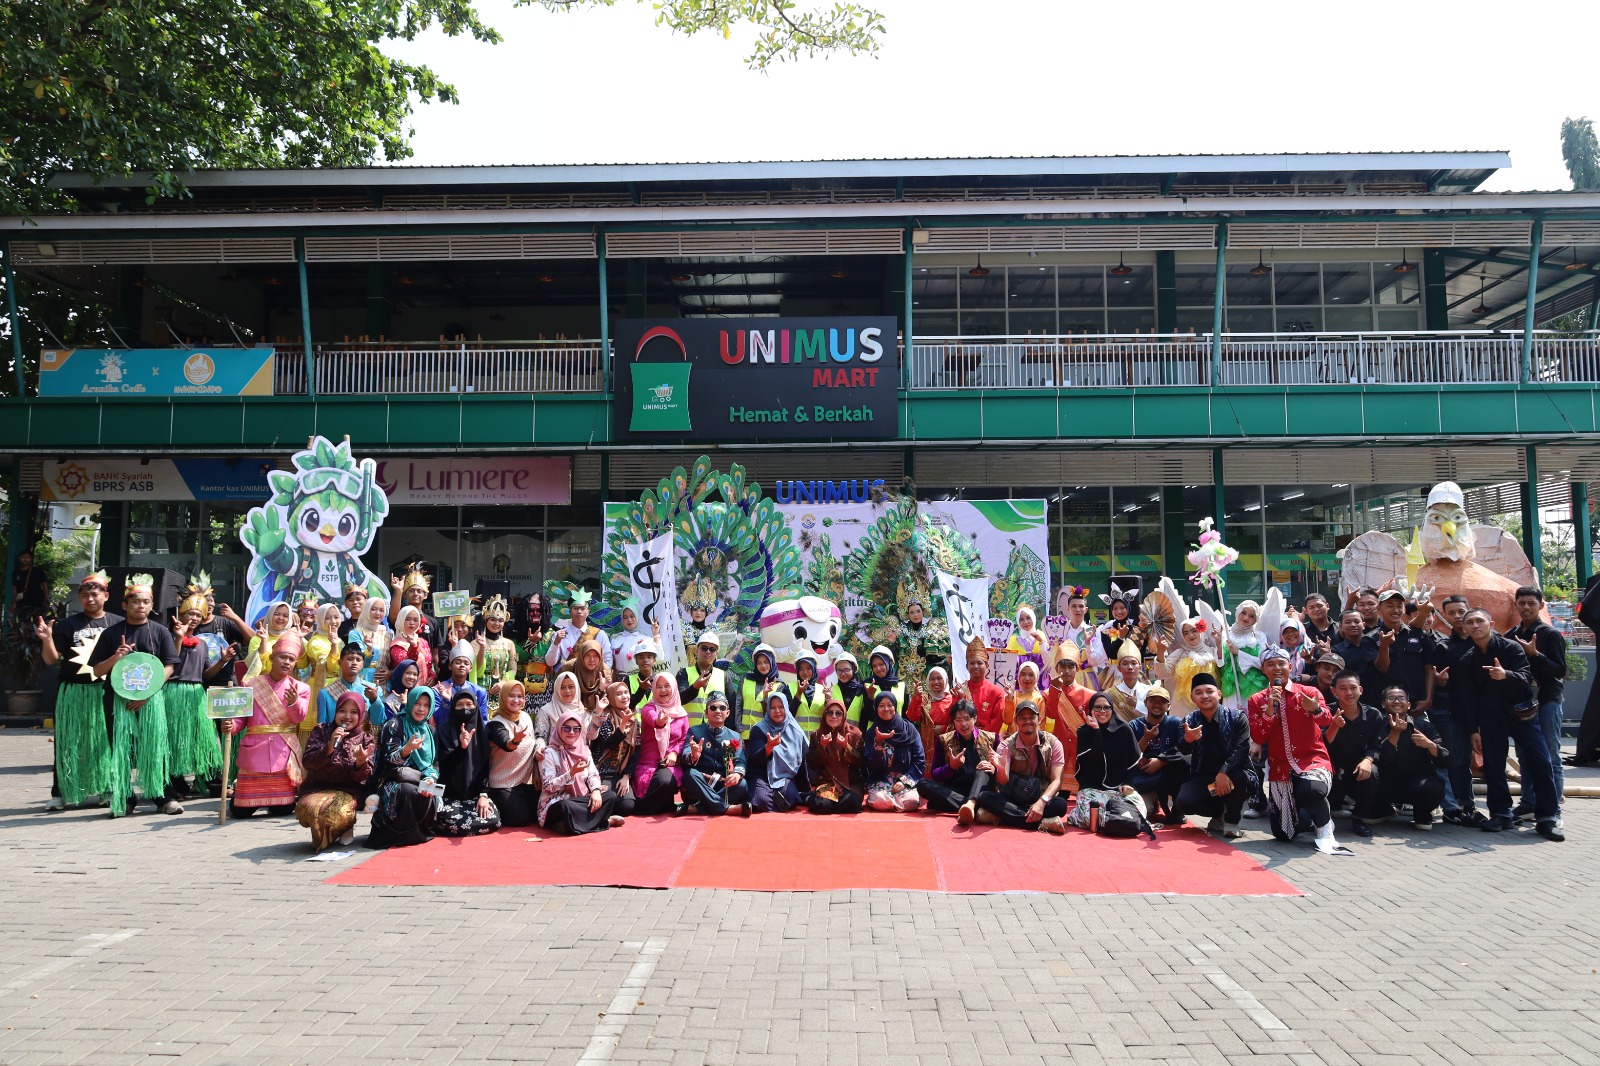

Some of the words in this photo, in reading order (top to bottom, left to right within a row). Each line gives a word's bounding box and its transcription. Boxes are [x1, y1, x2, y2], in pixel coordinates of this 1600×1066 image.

[719, 327, 884, 365] UNIMUS
[812, 367, 880, 388] MART
[729, 406, 788, 423] Hemat
[793, 406, 810, 422] &
[814, 404, 874, 422] Berkah
[122, 472, 153, 481] Syariah
[93, 481, 125, 492] BPRS
[129, 481, 154, 492] ASB
[200, 484, 225, 492] Kantor
[226, 484, 239, 492] kas
[240, 484, 270, 492] UNIMUS
[321, 574, 339, 582] FSTP
[439, 597, 465, 609] FSTP
[987, 619, 1012, 628] MOLAR
[1045, 615, 1067, 627] FKG
[213, 697, 247, 707] FIKKES
